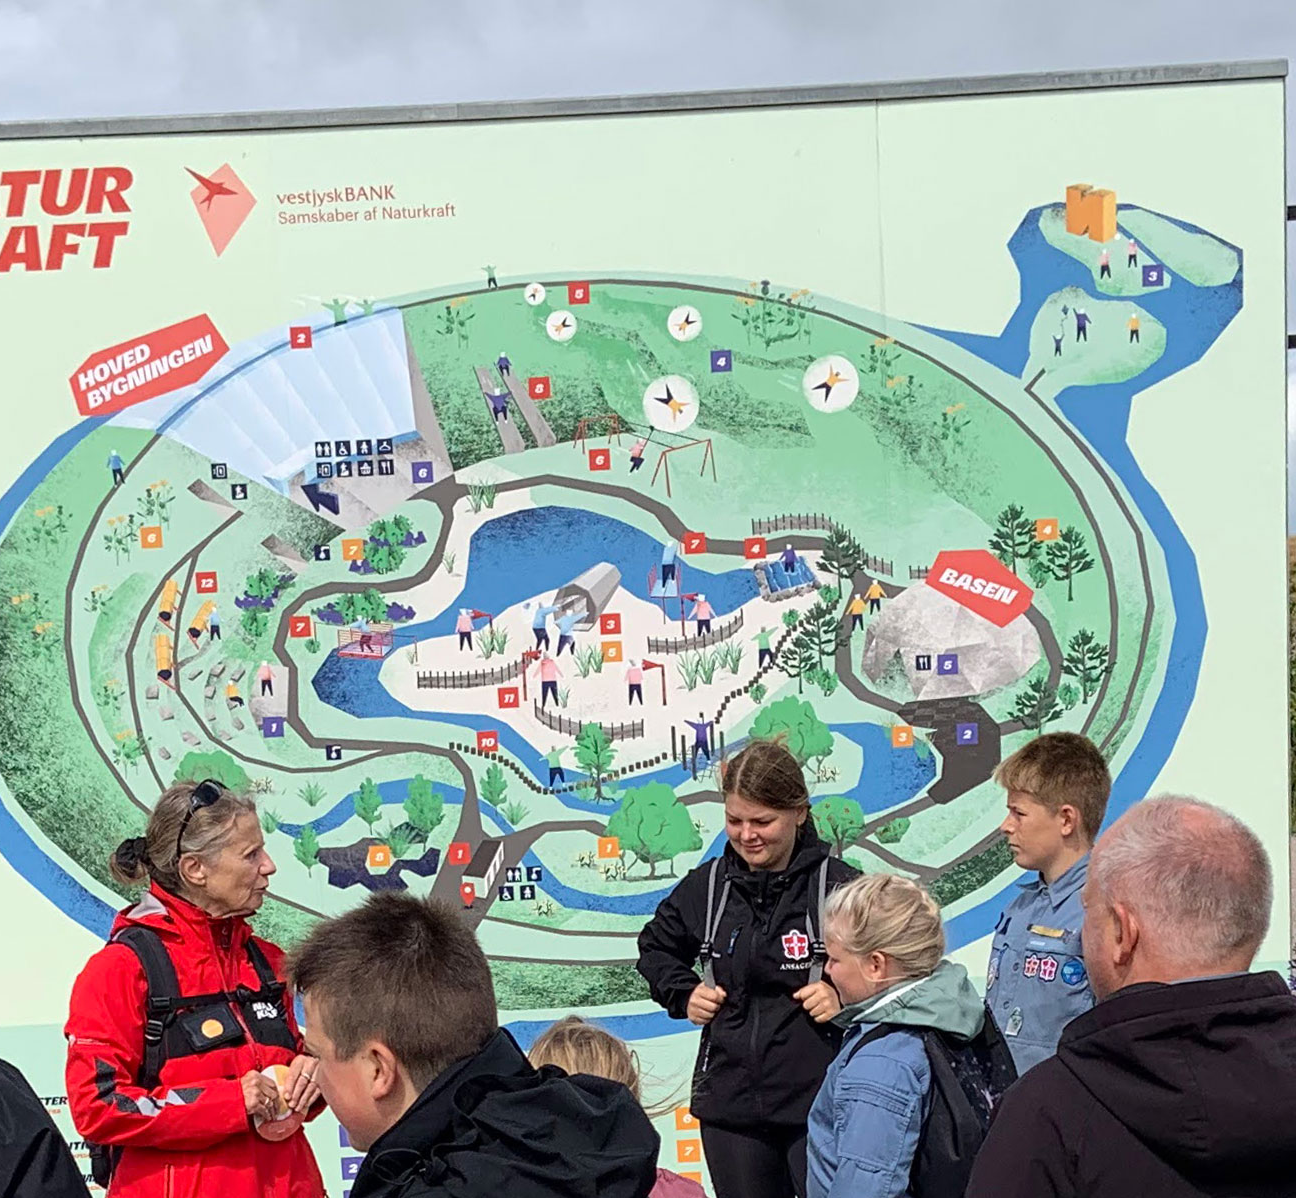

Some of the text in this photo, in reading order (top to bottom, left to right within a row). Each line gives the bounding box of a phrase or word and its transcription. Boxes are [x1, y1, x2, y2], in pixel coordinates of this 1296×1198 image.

[276, 185, 396, 208] vestjyskBANK
[278, 203, 456, 225] Samskaber af Naturkraft
[1149, 272, 1157, 281] 3
[575, 289, 583, 298] 5
[297, 334, 305, 343] 2
[717, 358, 725, 366] 4
[78, 343, 151, 391] HOVED
[86, 334, 214, 410] BYGNINGEN
[535, 384, 544, 393] 8
[596, 456, 604, 465] 6
[419, 469, 427, 478] 6
[1043, 526, 1051, 534] 4
[148, 534, 156, 543] 6
[691, 540, 699, 548] 7
[350, 546, 357, 555] 7
[751, 545, 759, 553] 4
[201, 579, 213, 587] 12
[939, 568, 1019, 605] BASEN
[297, 623, 305, 631] 7
[607, 620, 615, 629] 3
[608, 648, 616, 657] 5
[944, 661, 952, 669] 5
[504, 694, 514, 702] 11
[899, 733, 907, 741] 3
[963, 730, 971, 739] 2
[482, 738, 495, 747] 10
[375, 853, 384, 861] 8
[683, 1113, 692, 1123] 6
[685, 1147, 694, 1155] 7
[349, 1164, 358, 1173] 2
